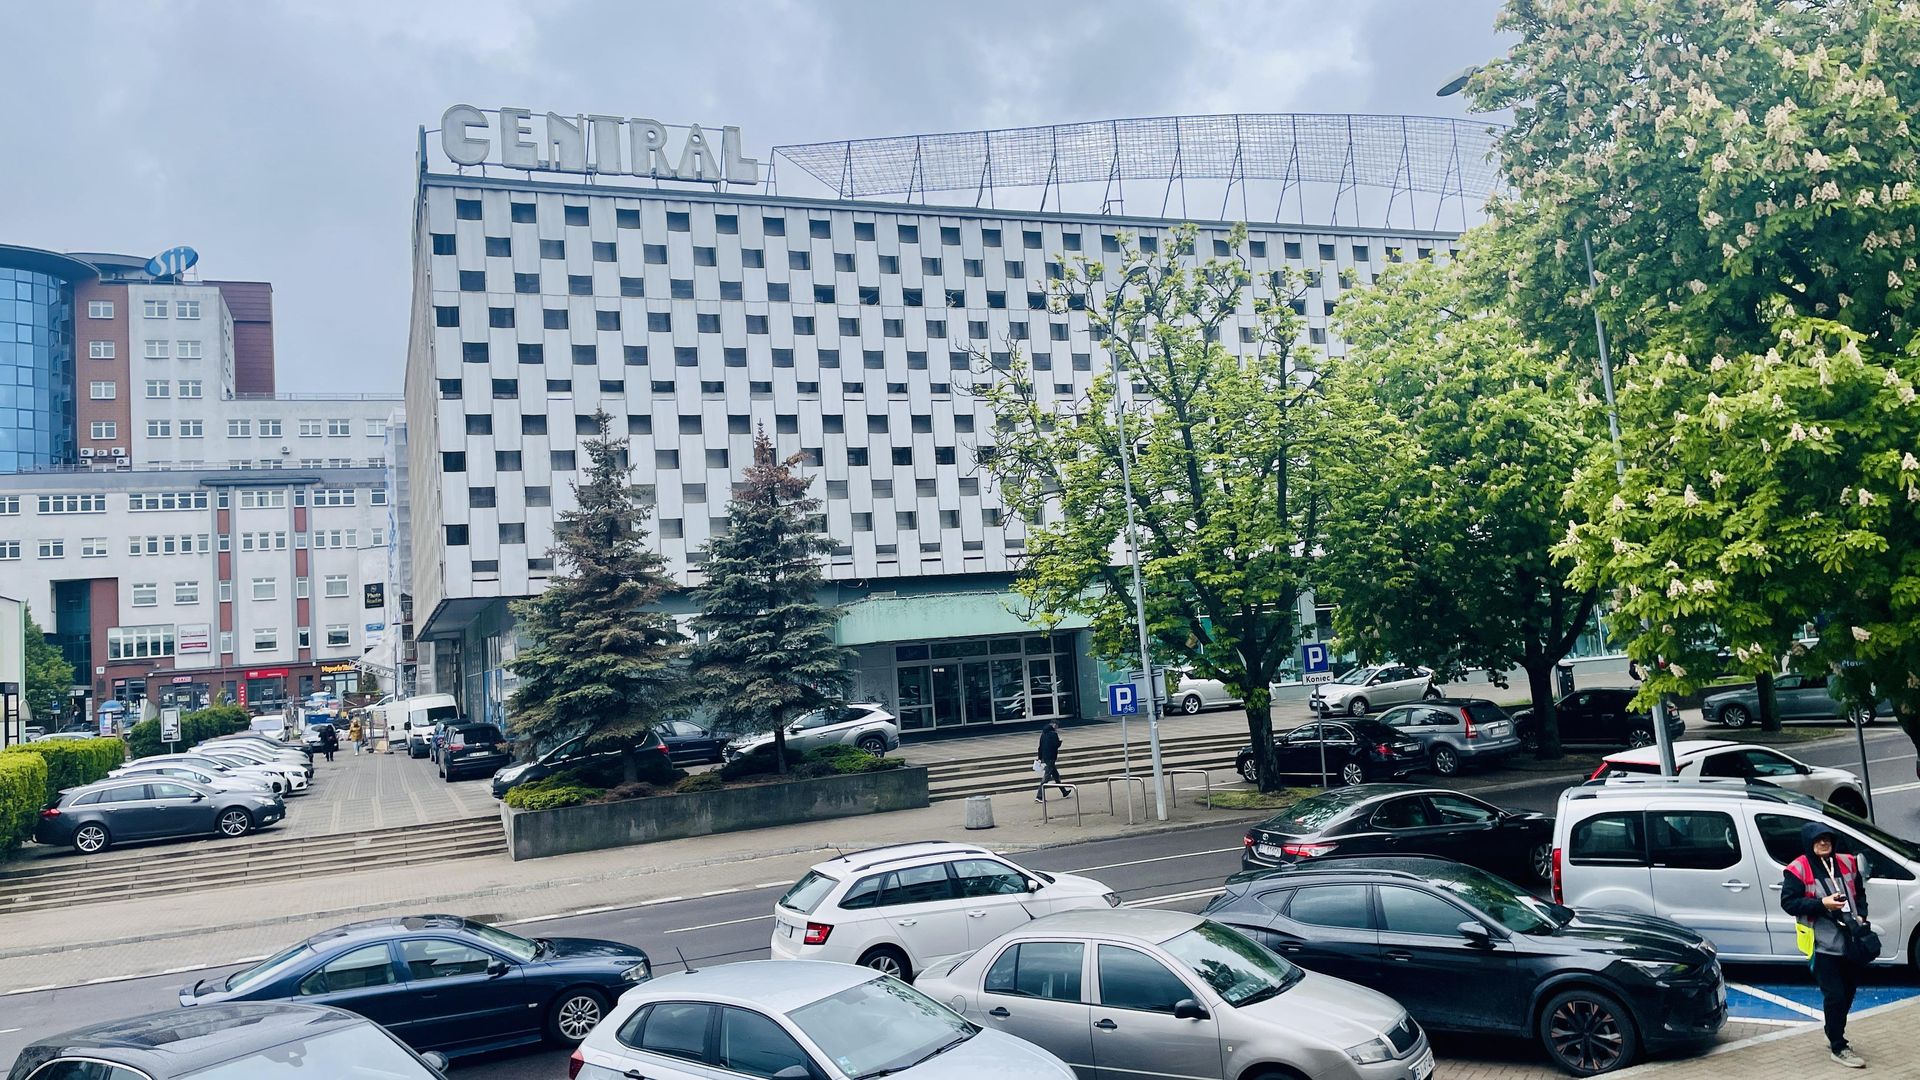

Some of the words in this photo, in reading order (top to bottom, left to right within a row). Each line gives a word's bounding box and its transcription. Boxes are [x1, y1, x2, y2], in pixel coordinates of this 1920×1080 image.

[441, 104, 758, 185] CENTRAL
[1308, 646, 1323, 669] P
[1305, 674, 1331, 683] Koniec
[1115, 687, 1132, 712] P
